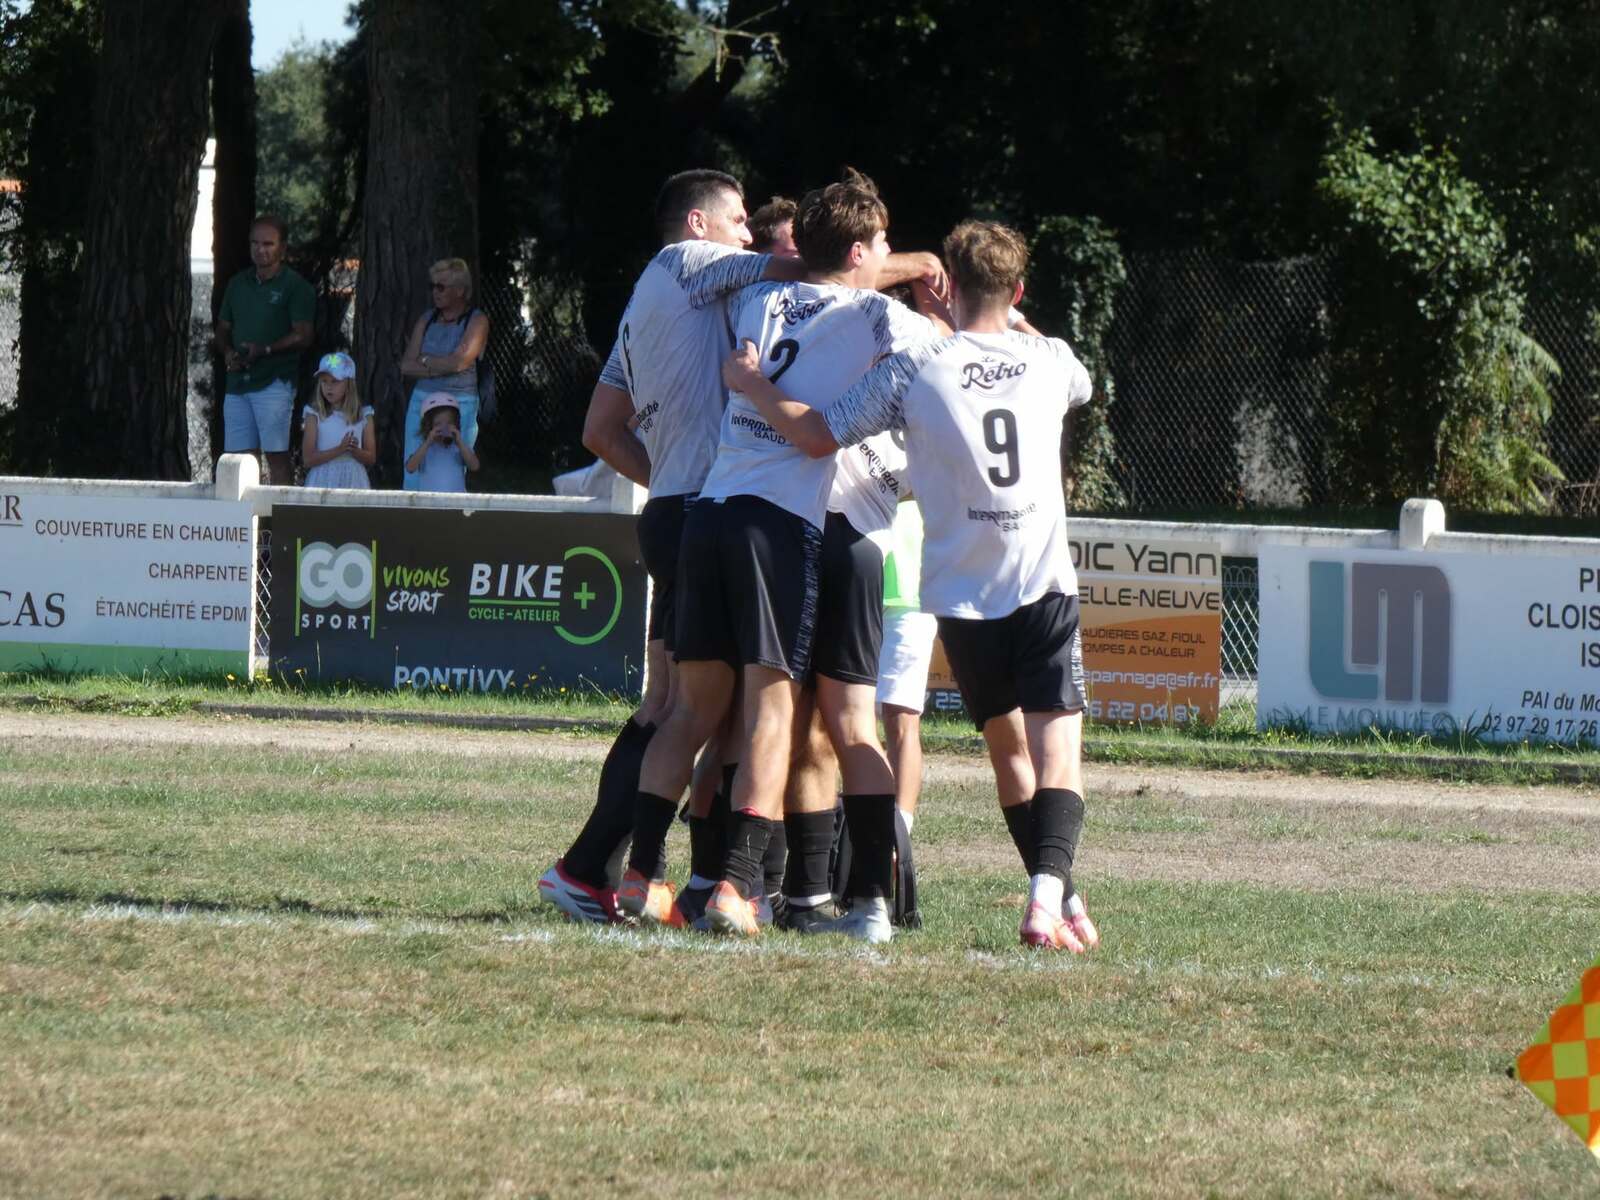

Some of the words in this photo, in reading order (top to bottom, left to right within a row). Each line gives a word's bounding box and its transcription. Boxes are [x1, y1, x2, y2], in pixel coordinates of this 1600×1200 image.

[769, 338, 800, 384] 2
[982, 408, 1021, 488] 9
[0, 494, 23, 520] R
[35, 519, 147, 539] COUVERTURE
[153, 523, 174, 540] EN
[179, 524, 249, 542] CHAUME
[149, 563, 248, 582] CHARPENTE
[1125, 544, 1218, 577] Yann
[300, 544, 373, 606] GO
[383, 565, 450, 589] VIVONS
[469, 563, 564, 599] BIKE
[1580, 567, 1600, 592] P
[96, 596, 196, 620] ÉTANCHÉITÉ
[201, 604, 247, 622] EPDM
[386, 590, 444, 615] SPORT
[468, 607, 560, 622] CYCLE-ATELIER
[301, 613, 371, 630] SPORT
[1528, 602, 1600, 631] CLOIS
[1127, 645, 1138, 655] A
[1140, 645, 1196, 658] CHALEUR
[394, 665, 515, 692] PONTIVY
[1554, 692, 1575, 710] du
[1507, 716, 1525, 734] 97
[1531, 716, 1549, 736] 29
[1555, 719, 1573, 736] 17
[1579, 720, 1597, 738] 26
